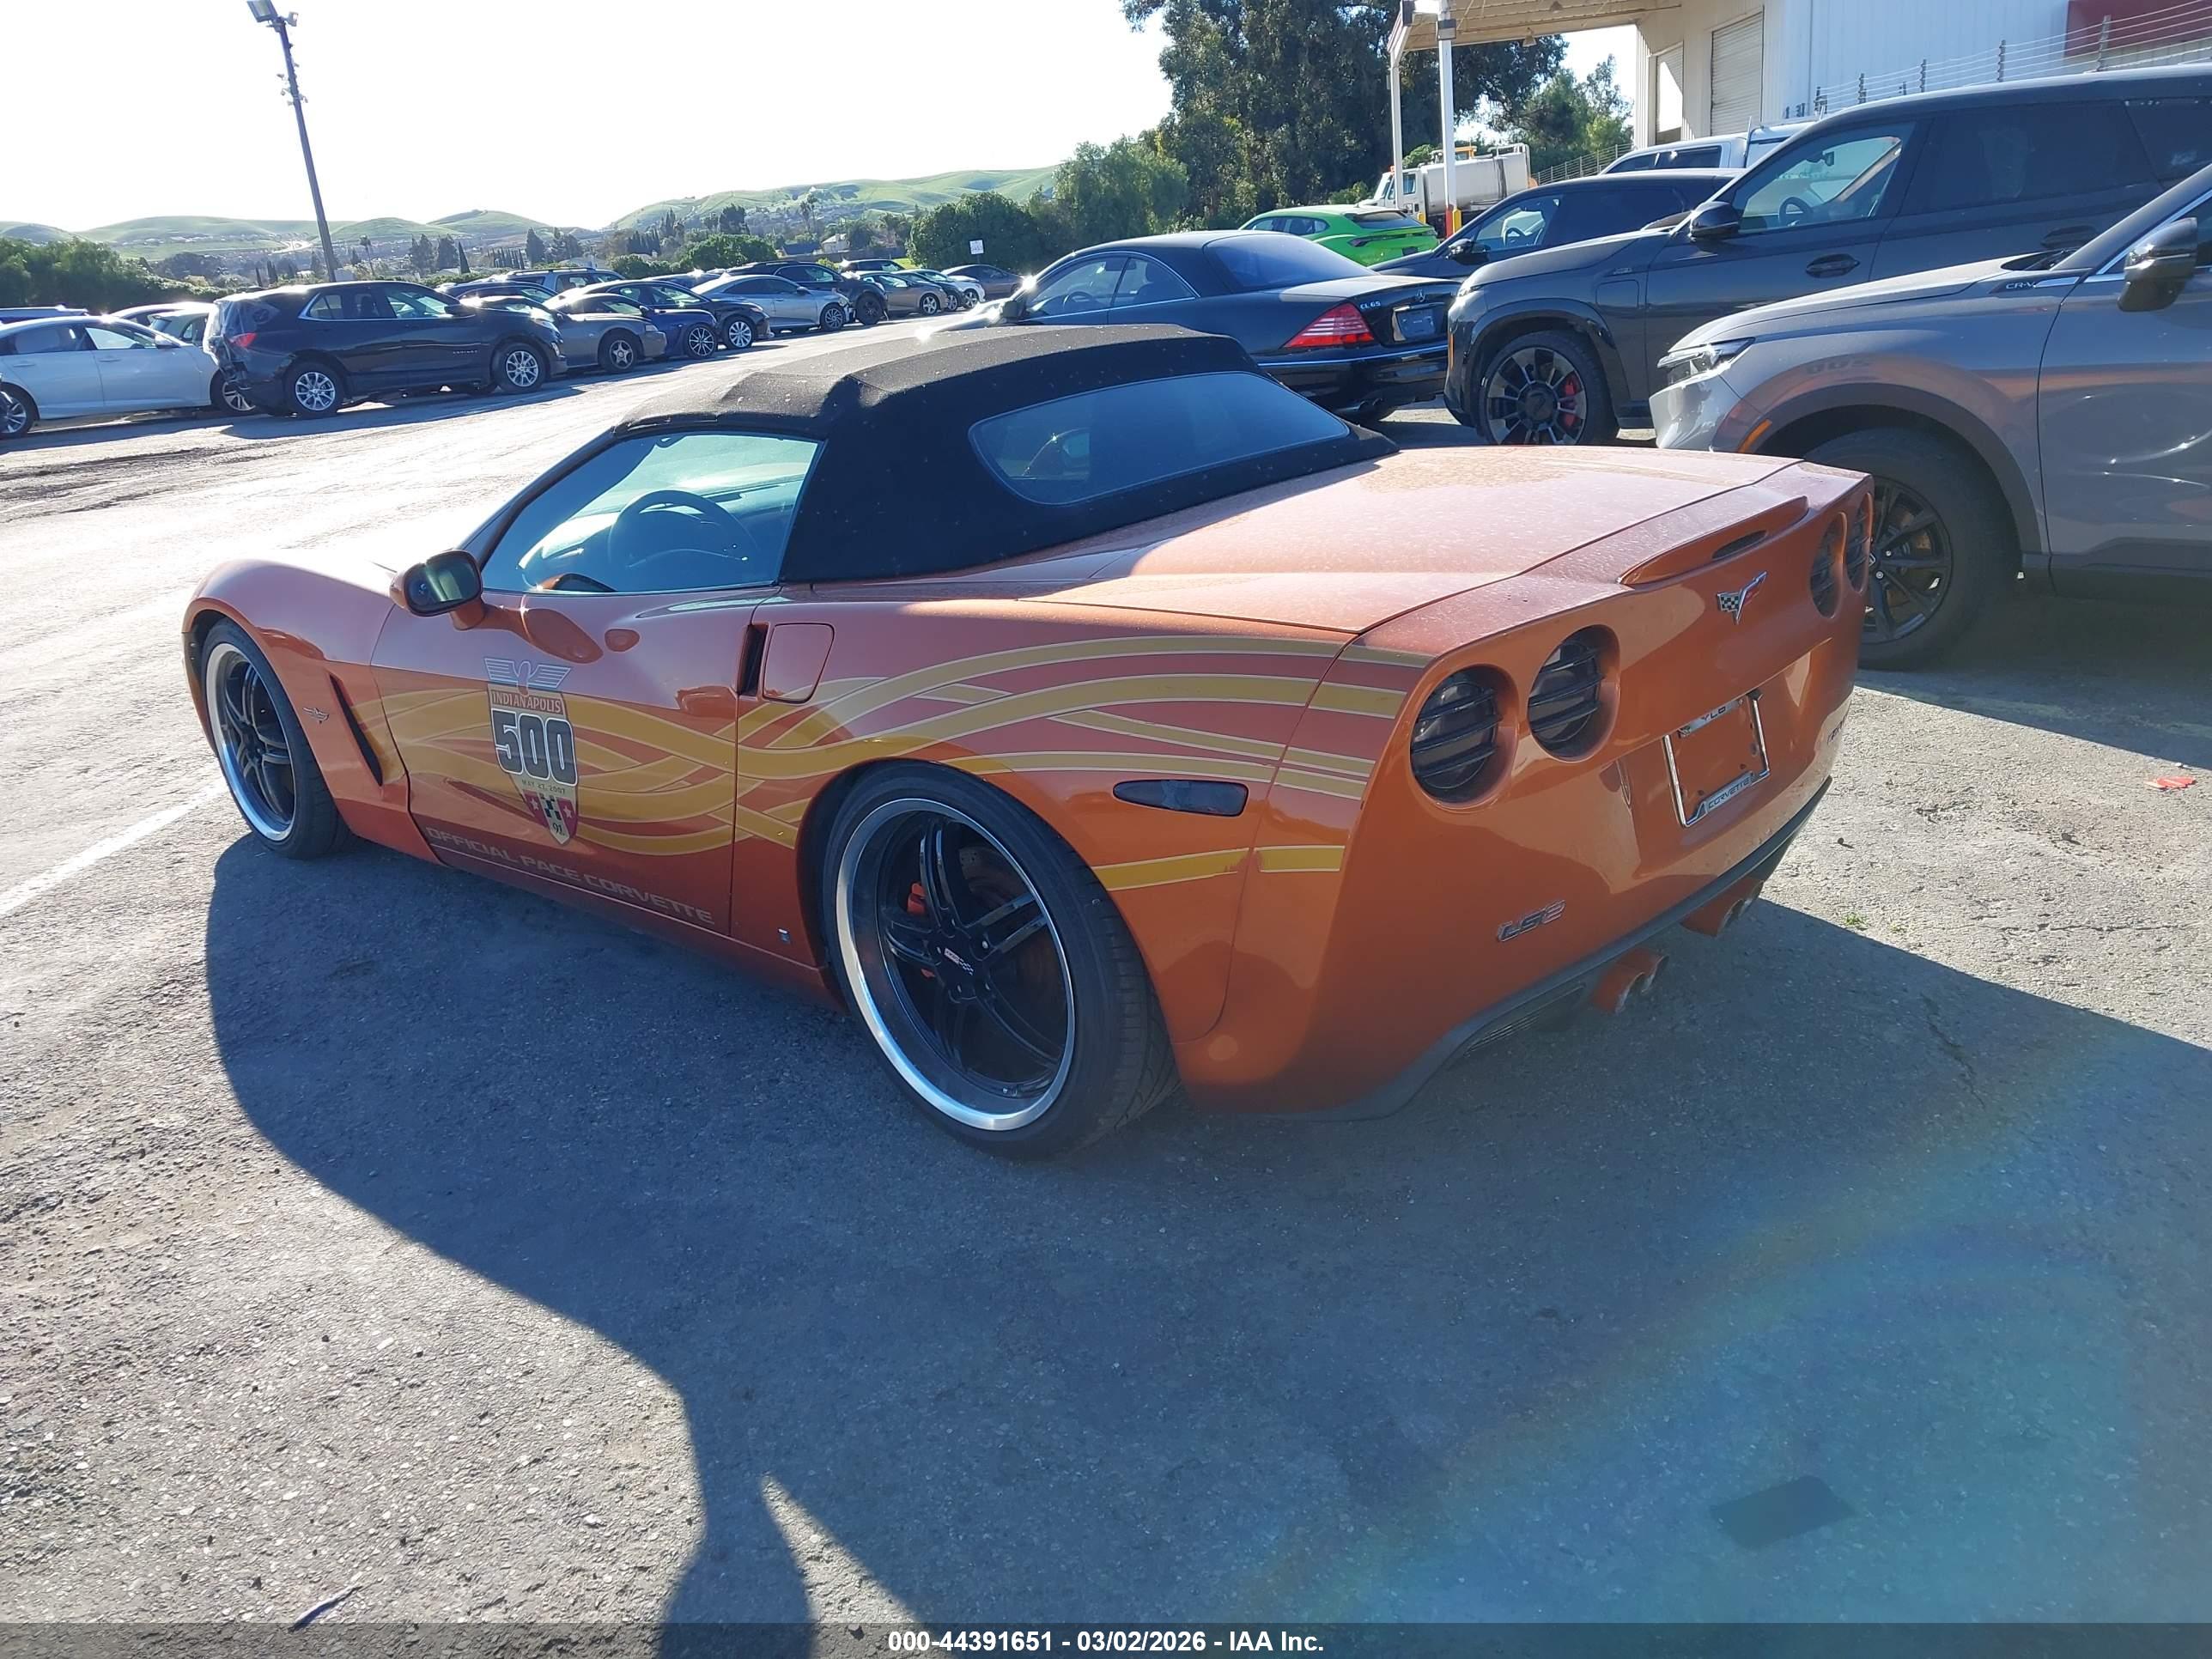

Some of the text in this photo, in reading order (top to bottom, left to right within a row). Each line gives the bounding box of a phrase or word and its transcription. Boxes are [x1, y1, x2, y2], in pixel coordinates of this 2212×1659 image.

[492, 690, 561, 714] INDIANAPOLIS
[491, 708, 578, 787] 500
[1707, 776, 1751, 810] CORVETTE
[426, 826, 715, 925] OFFICIAL PACE CORVETTE
[1497, 899, 1566, 942] LS2
